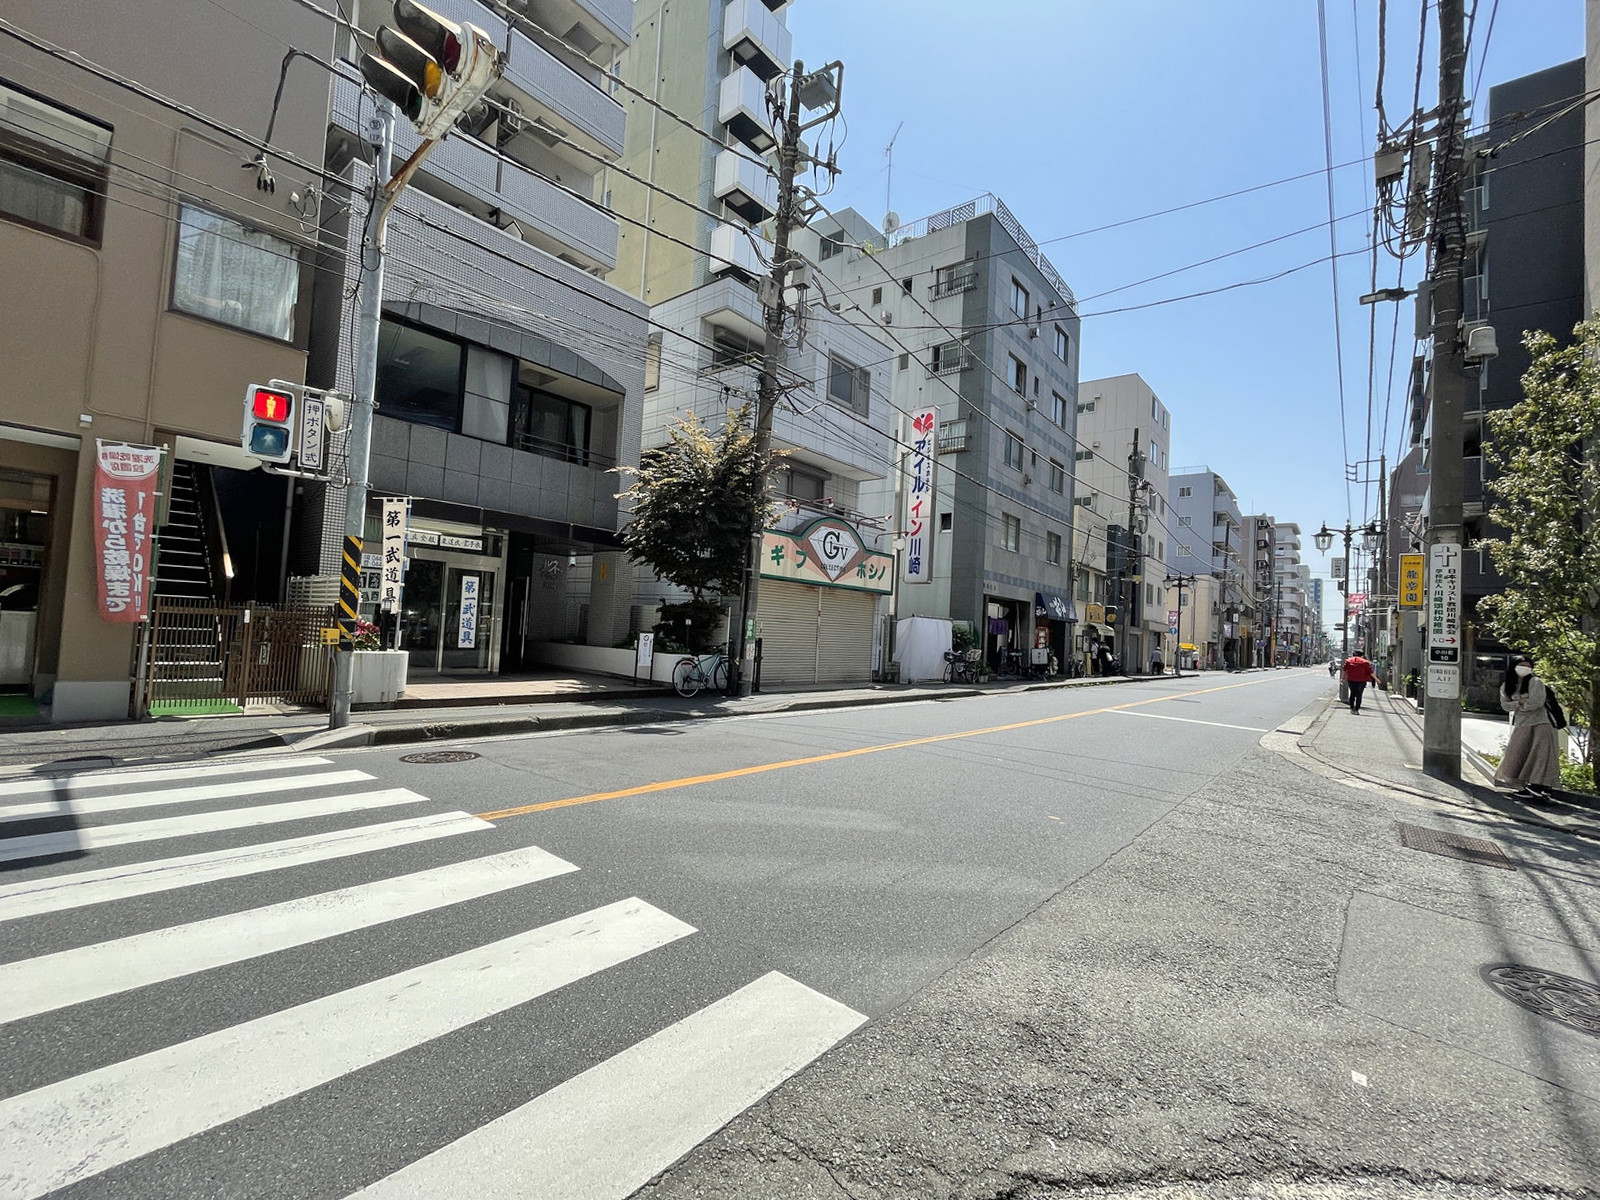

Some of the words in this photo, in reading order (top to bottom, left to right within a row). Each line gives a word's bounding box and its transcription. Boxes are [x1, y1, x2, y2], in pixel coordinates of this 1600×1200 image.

[304, 404, 320, 463] 押ボタン式
[908, 440, 927, 575] アイル・イン川崎
[382, 510, 401, 603] 第一武道具
[460, 580, 477, 645] 第一武道具
[1446, 568, 1457, 635] 日本キリスト教団川崎教会
